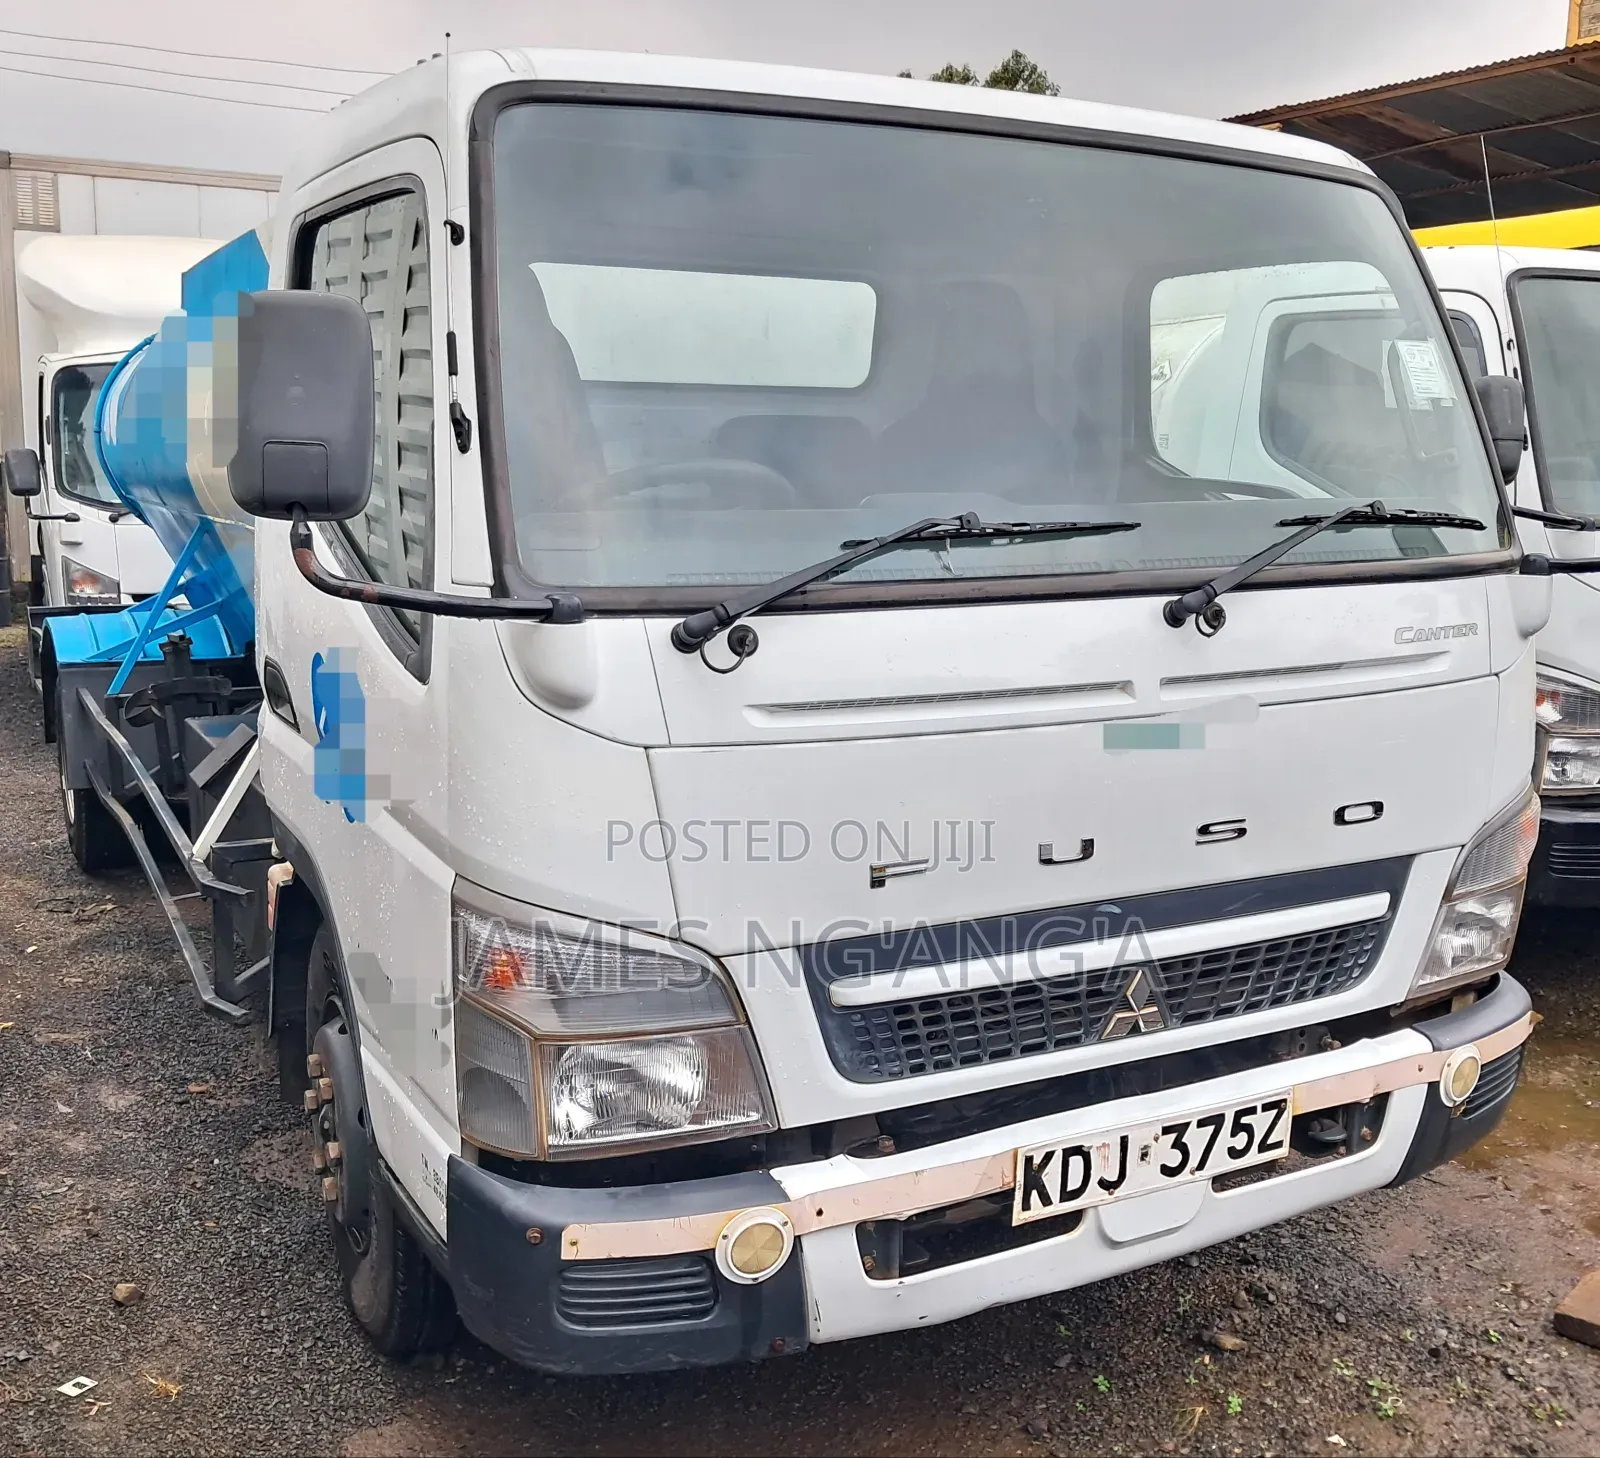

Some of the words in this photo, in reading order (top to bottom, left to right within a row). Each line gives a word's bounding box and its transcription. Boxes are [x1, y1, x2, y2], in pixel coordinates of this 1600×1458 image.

[1394, 622, 1478, 644] CANTER
[870, 800, 1385, 889] FUSO
[1022, 1135, 1130, 1212] KDJ
[1160, 1098, 1288, 1178] 375Z
